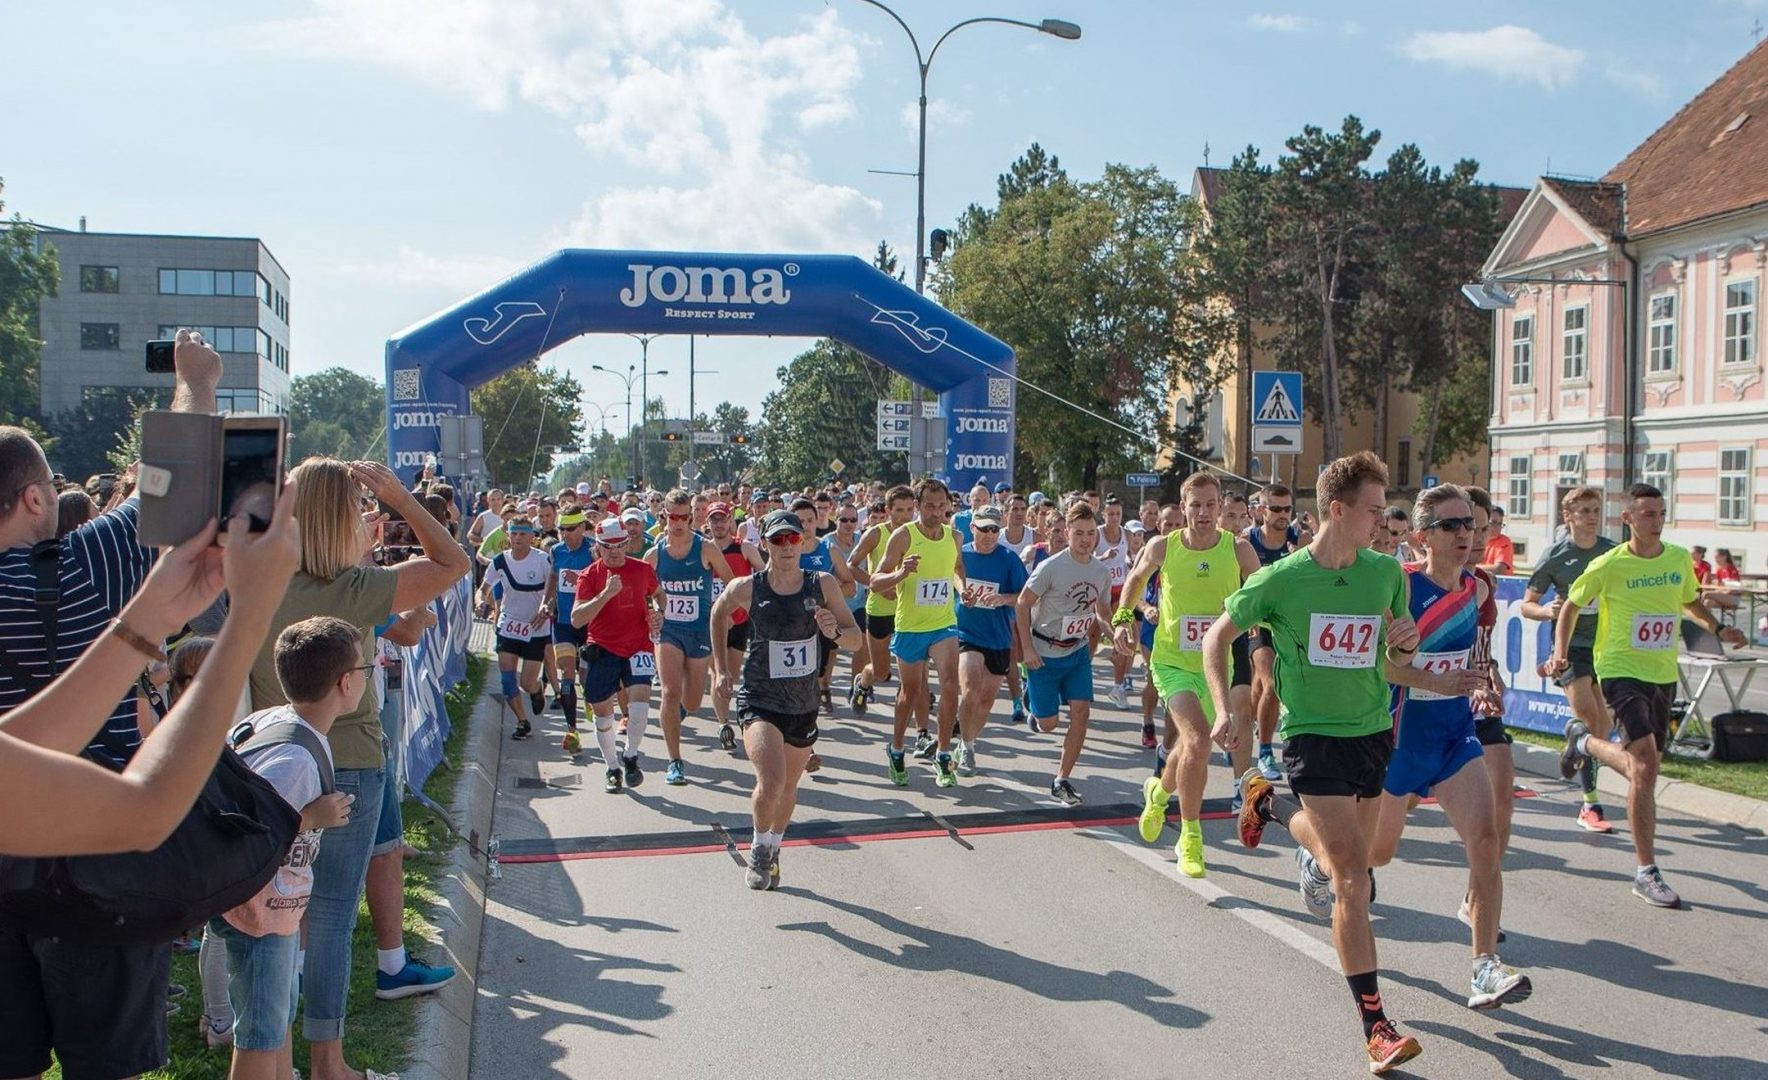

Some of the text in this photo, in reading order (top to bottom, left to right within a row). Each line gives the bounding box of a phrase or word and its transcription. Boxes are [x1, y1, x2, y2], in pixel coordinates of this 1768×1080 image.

[1627, 572, 1667, 589] unicef
[923, 582, 948, 599] 174
[669, 600, 694, 614] 123
[506, 621, 530, 637] 646
[1638, 621, 1674, 642] 699
[1319, 623, 1373, 653] 642
[783, 646, 807, 668] 31
